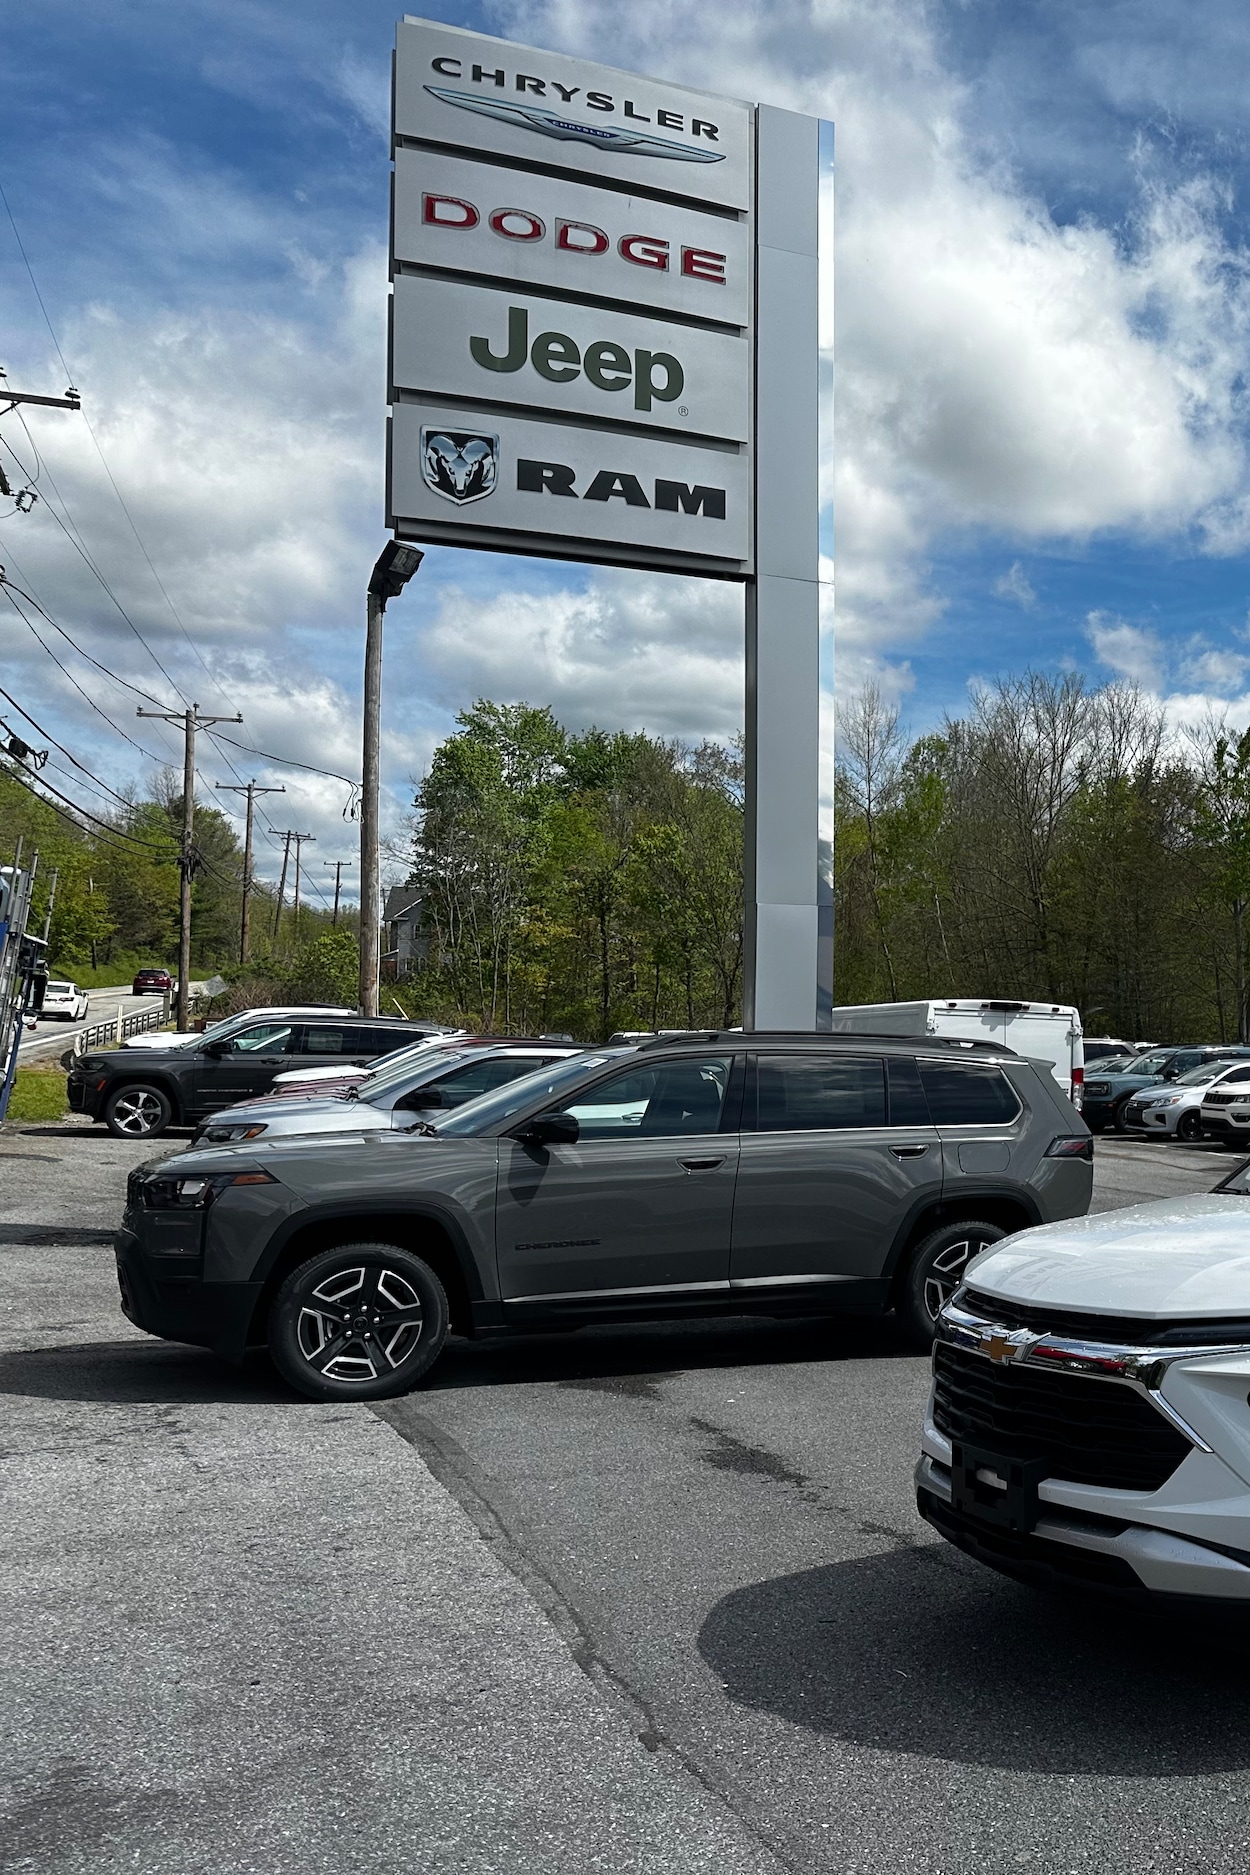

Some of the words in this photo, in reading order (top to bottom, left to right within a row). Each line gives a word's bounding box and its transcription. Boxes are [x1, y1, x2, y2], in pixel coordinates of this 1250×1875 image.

[431, 57, 721, 142] CHRYSLER
[552, 121, 611, 138] CHRYSLER
[421, 192, 727, 286] DODGE
[469, 306, 684, 411] Jeep
[516, 458, 727, 520] RAM
